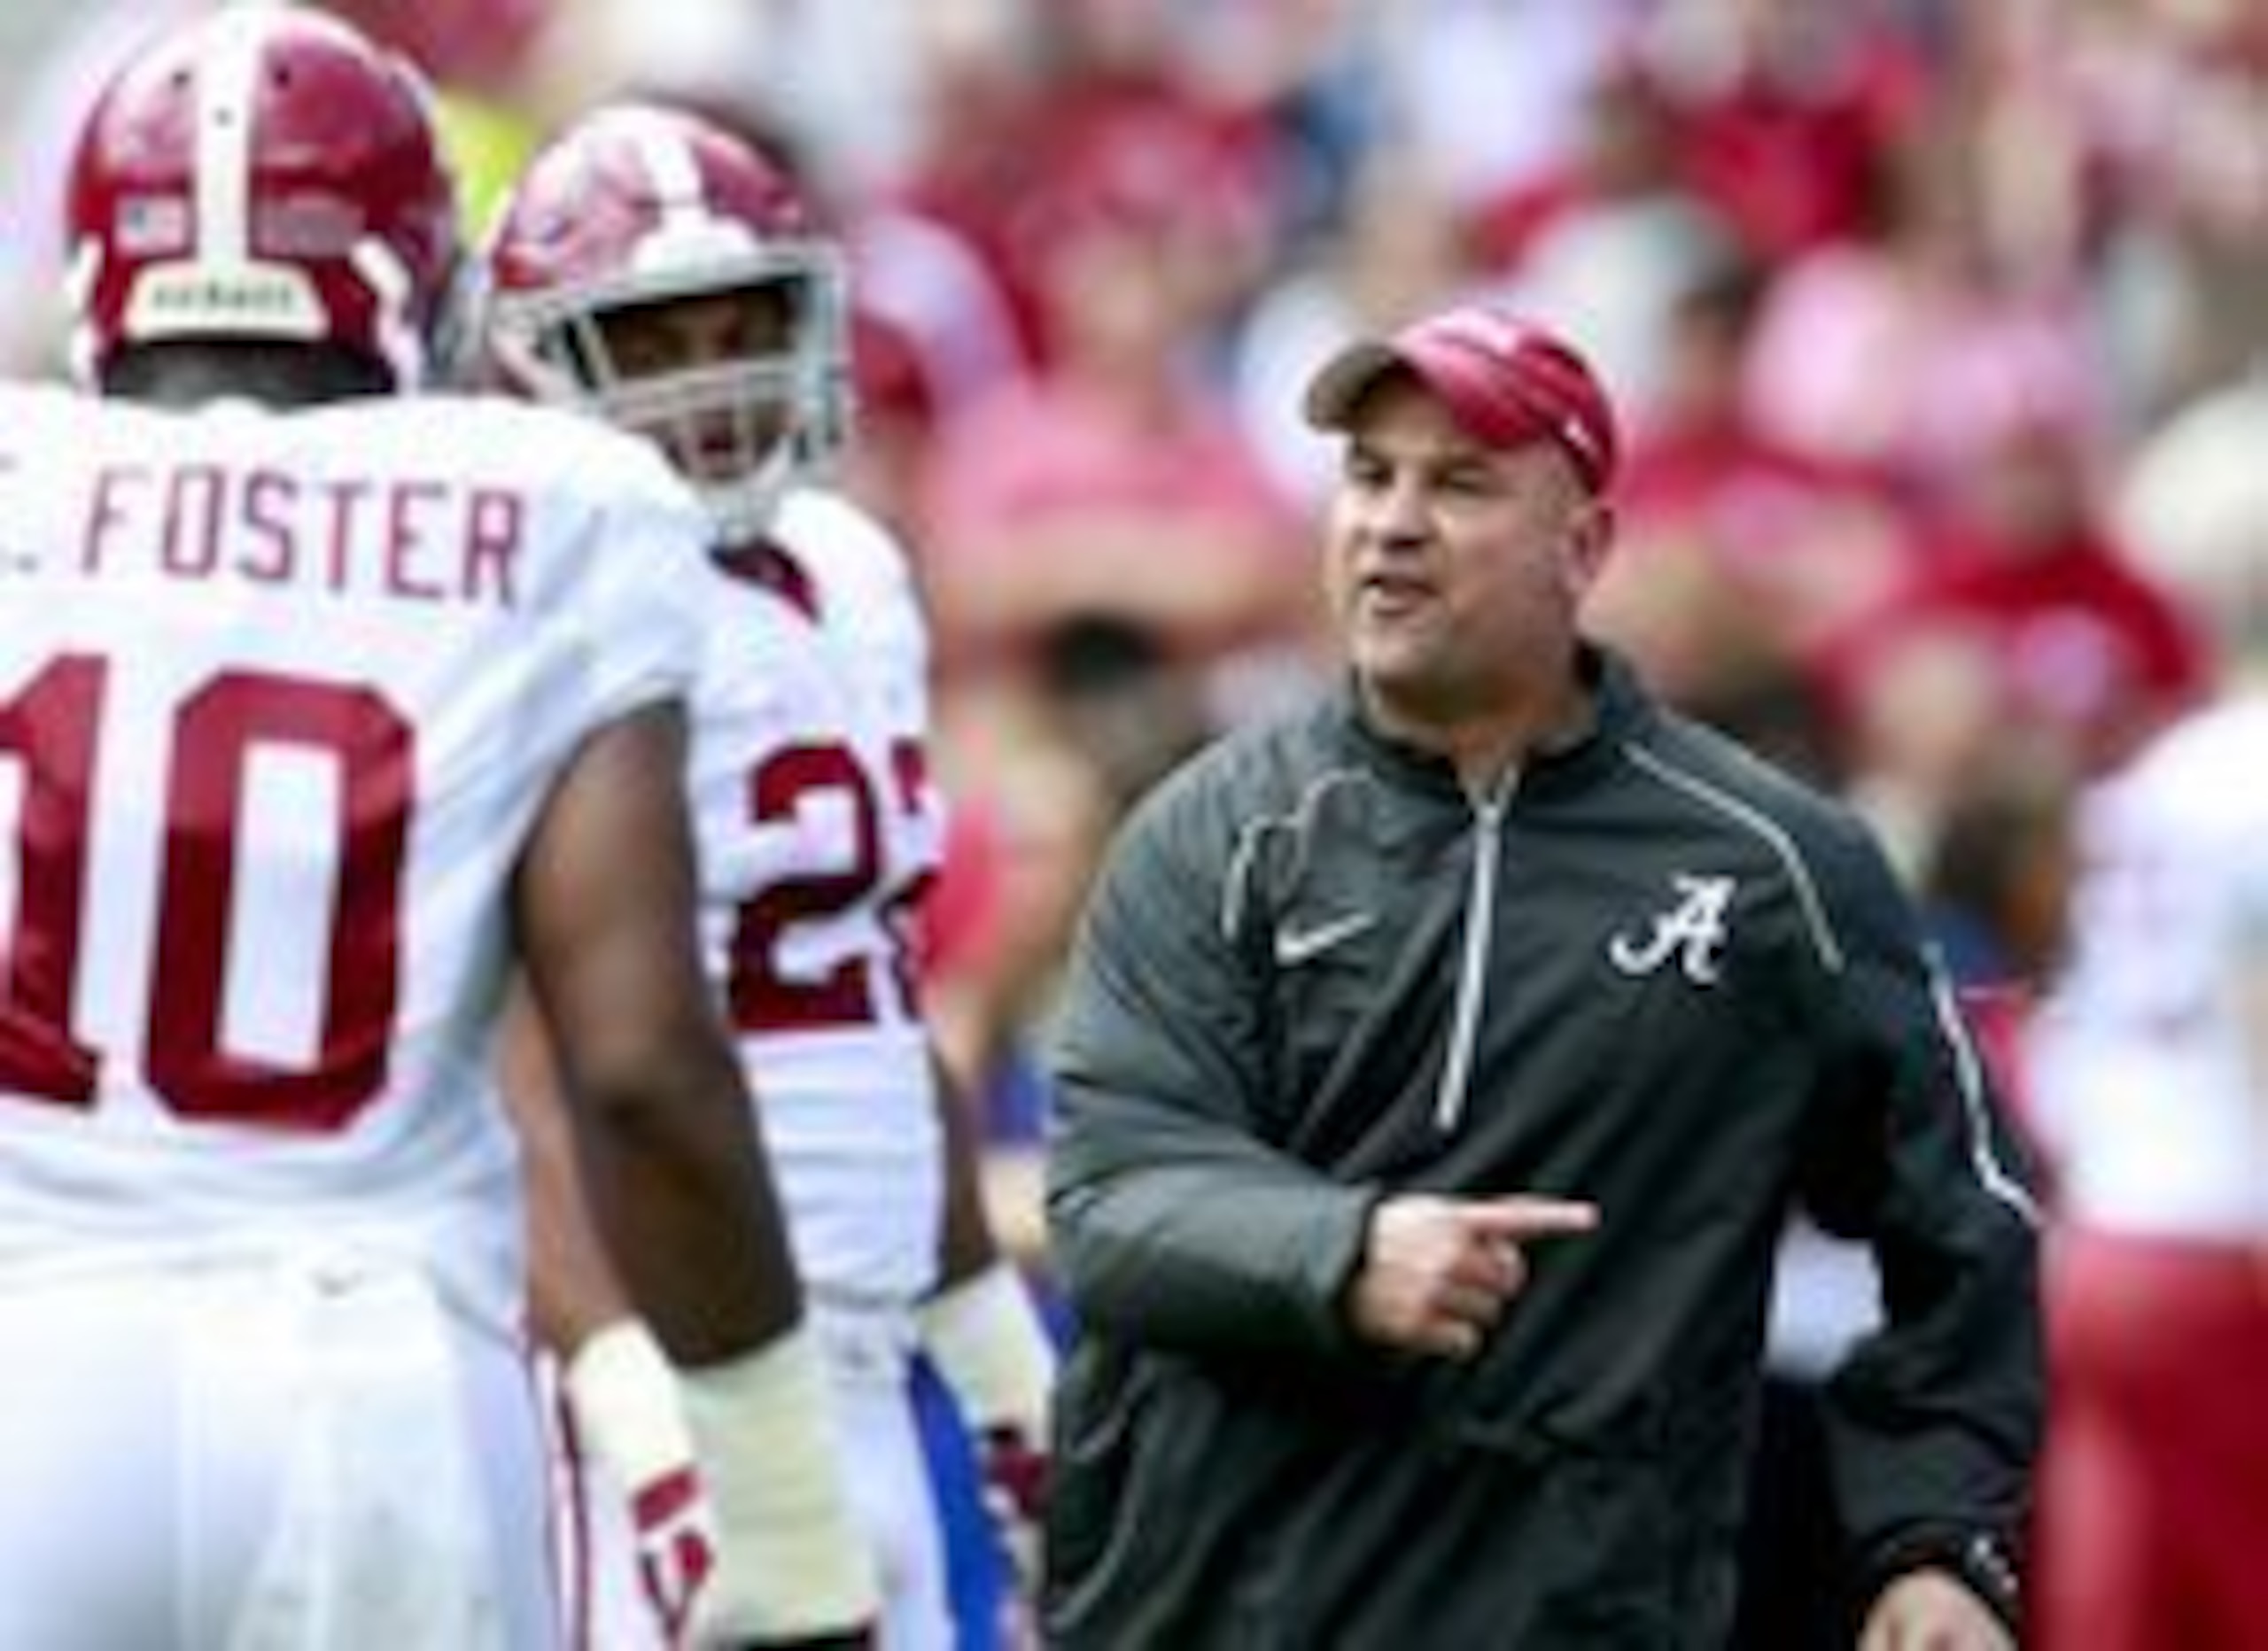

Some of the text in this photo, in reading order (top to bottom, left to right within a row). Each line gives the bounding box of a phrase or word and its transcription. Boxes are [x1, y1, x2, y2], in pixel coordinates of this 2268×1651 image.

[82, 464, 530, 608] FOSTER
[0, 654, 416, 1140] 10
[1610, 872, 1735, 983] A
